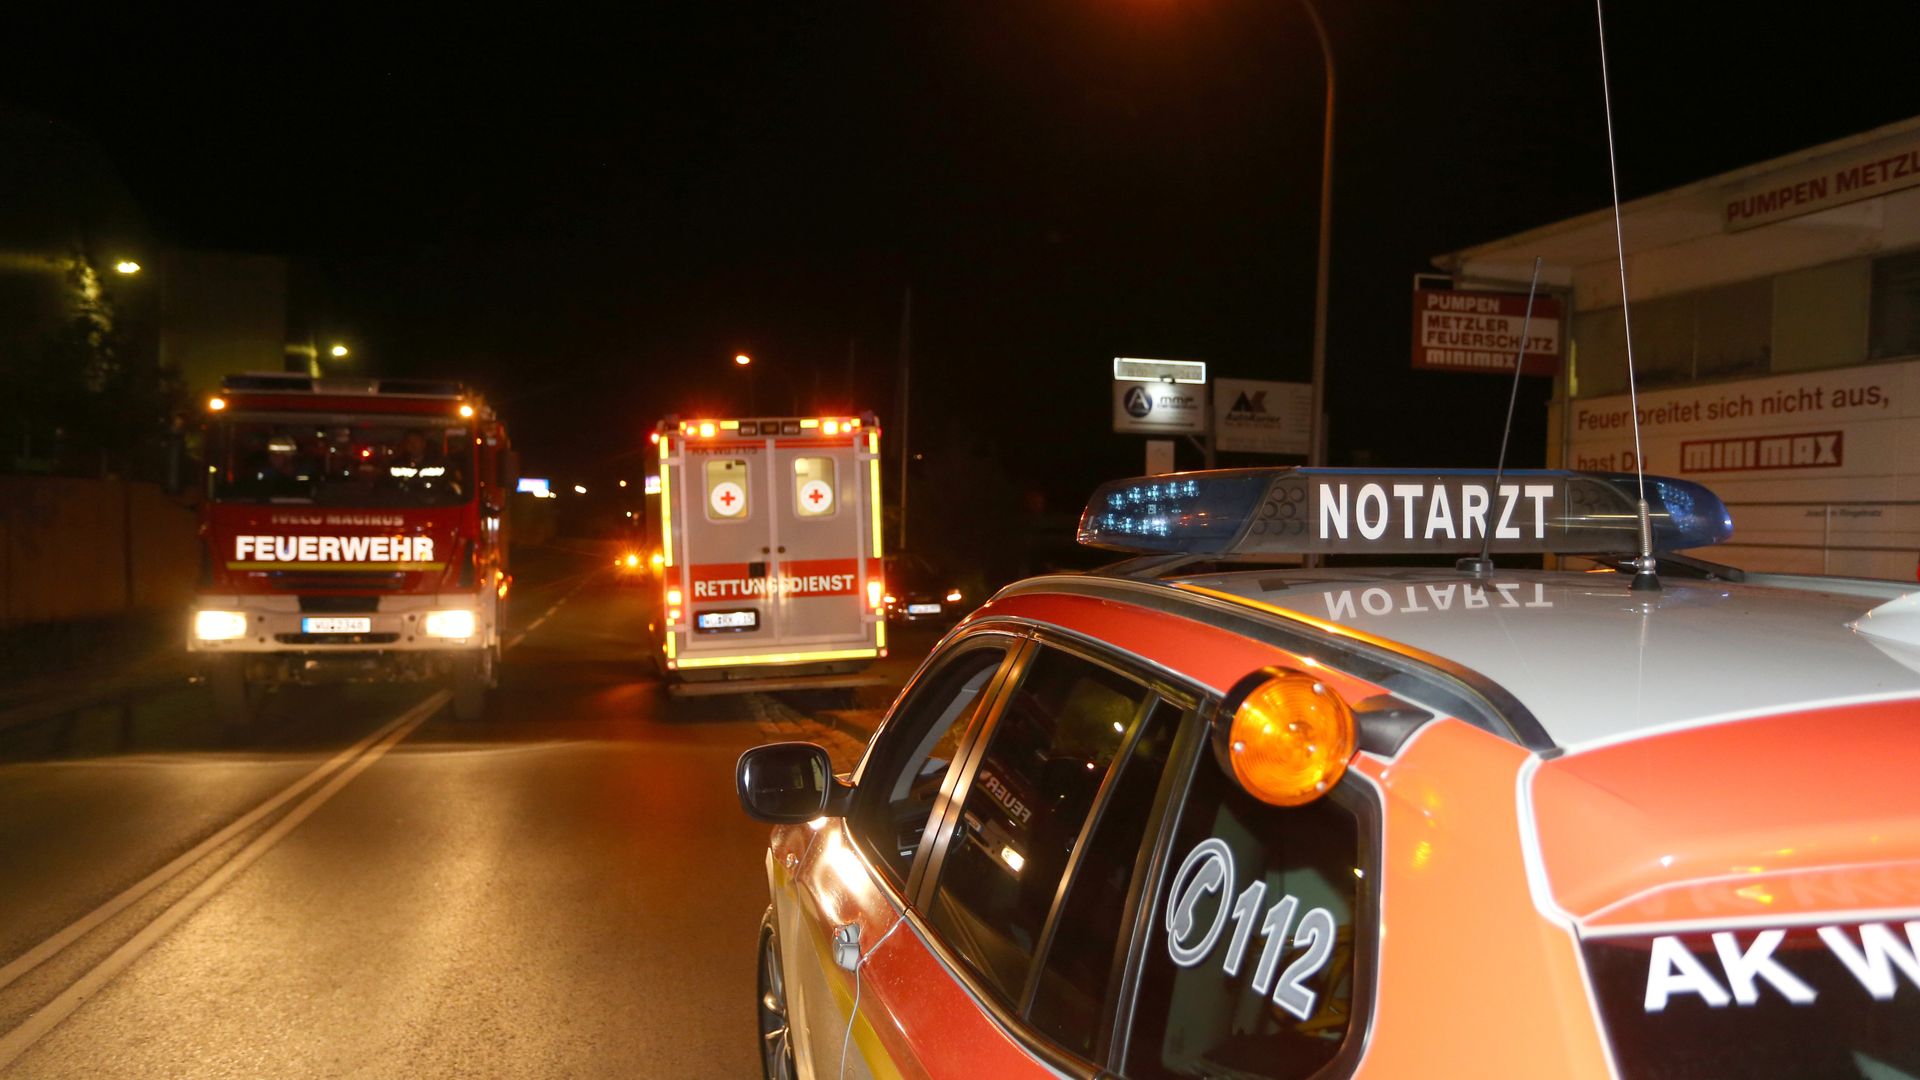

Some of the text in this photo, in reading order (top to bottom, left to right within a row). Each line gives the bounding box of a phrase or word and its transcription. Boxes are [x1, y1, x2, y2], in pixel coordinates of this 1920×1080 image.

[1727, 177, 1828, 222] PUMPEN
[1427, 294, 1500, 313] PUMPEN
[1427, 314, 1509, 332] METZLER
[1578, 384, 1889, 431] Feuer breitet sich nicht aus,
[1577, 453, 1615, 472] hast
[1319, 483, 1554, 540] NOTARZT
[236, 535, 434, 561] FEUERWEHR
[694, 574, 855, 598] RETTUNGSDIENST
[1223, 880, 1336, 1020] 112
[1644, 929, 1818, 1013] AK
